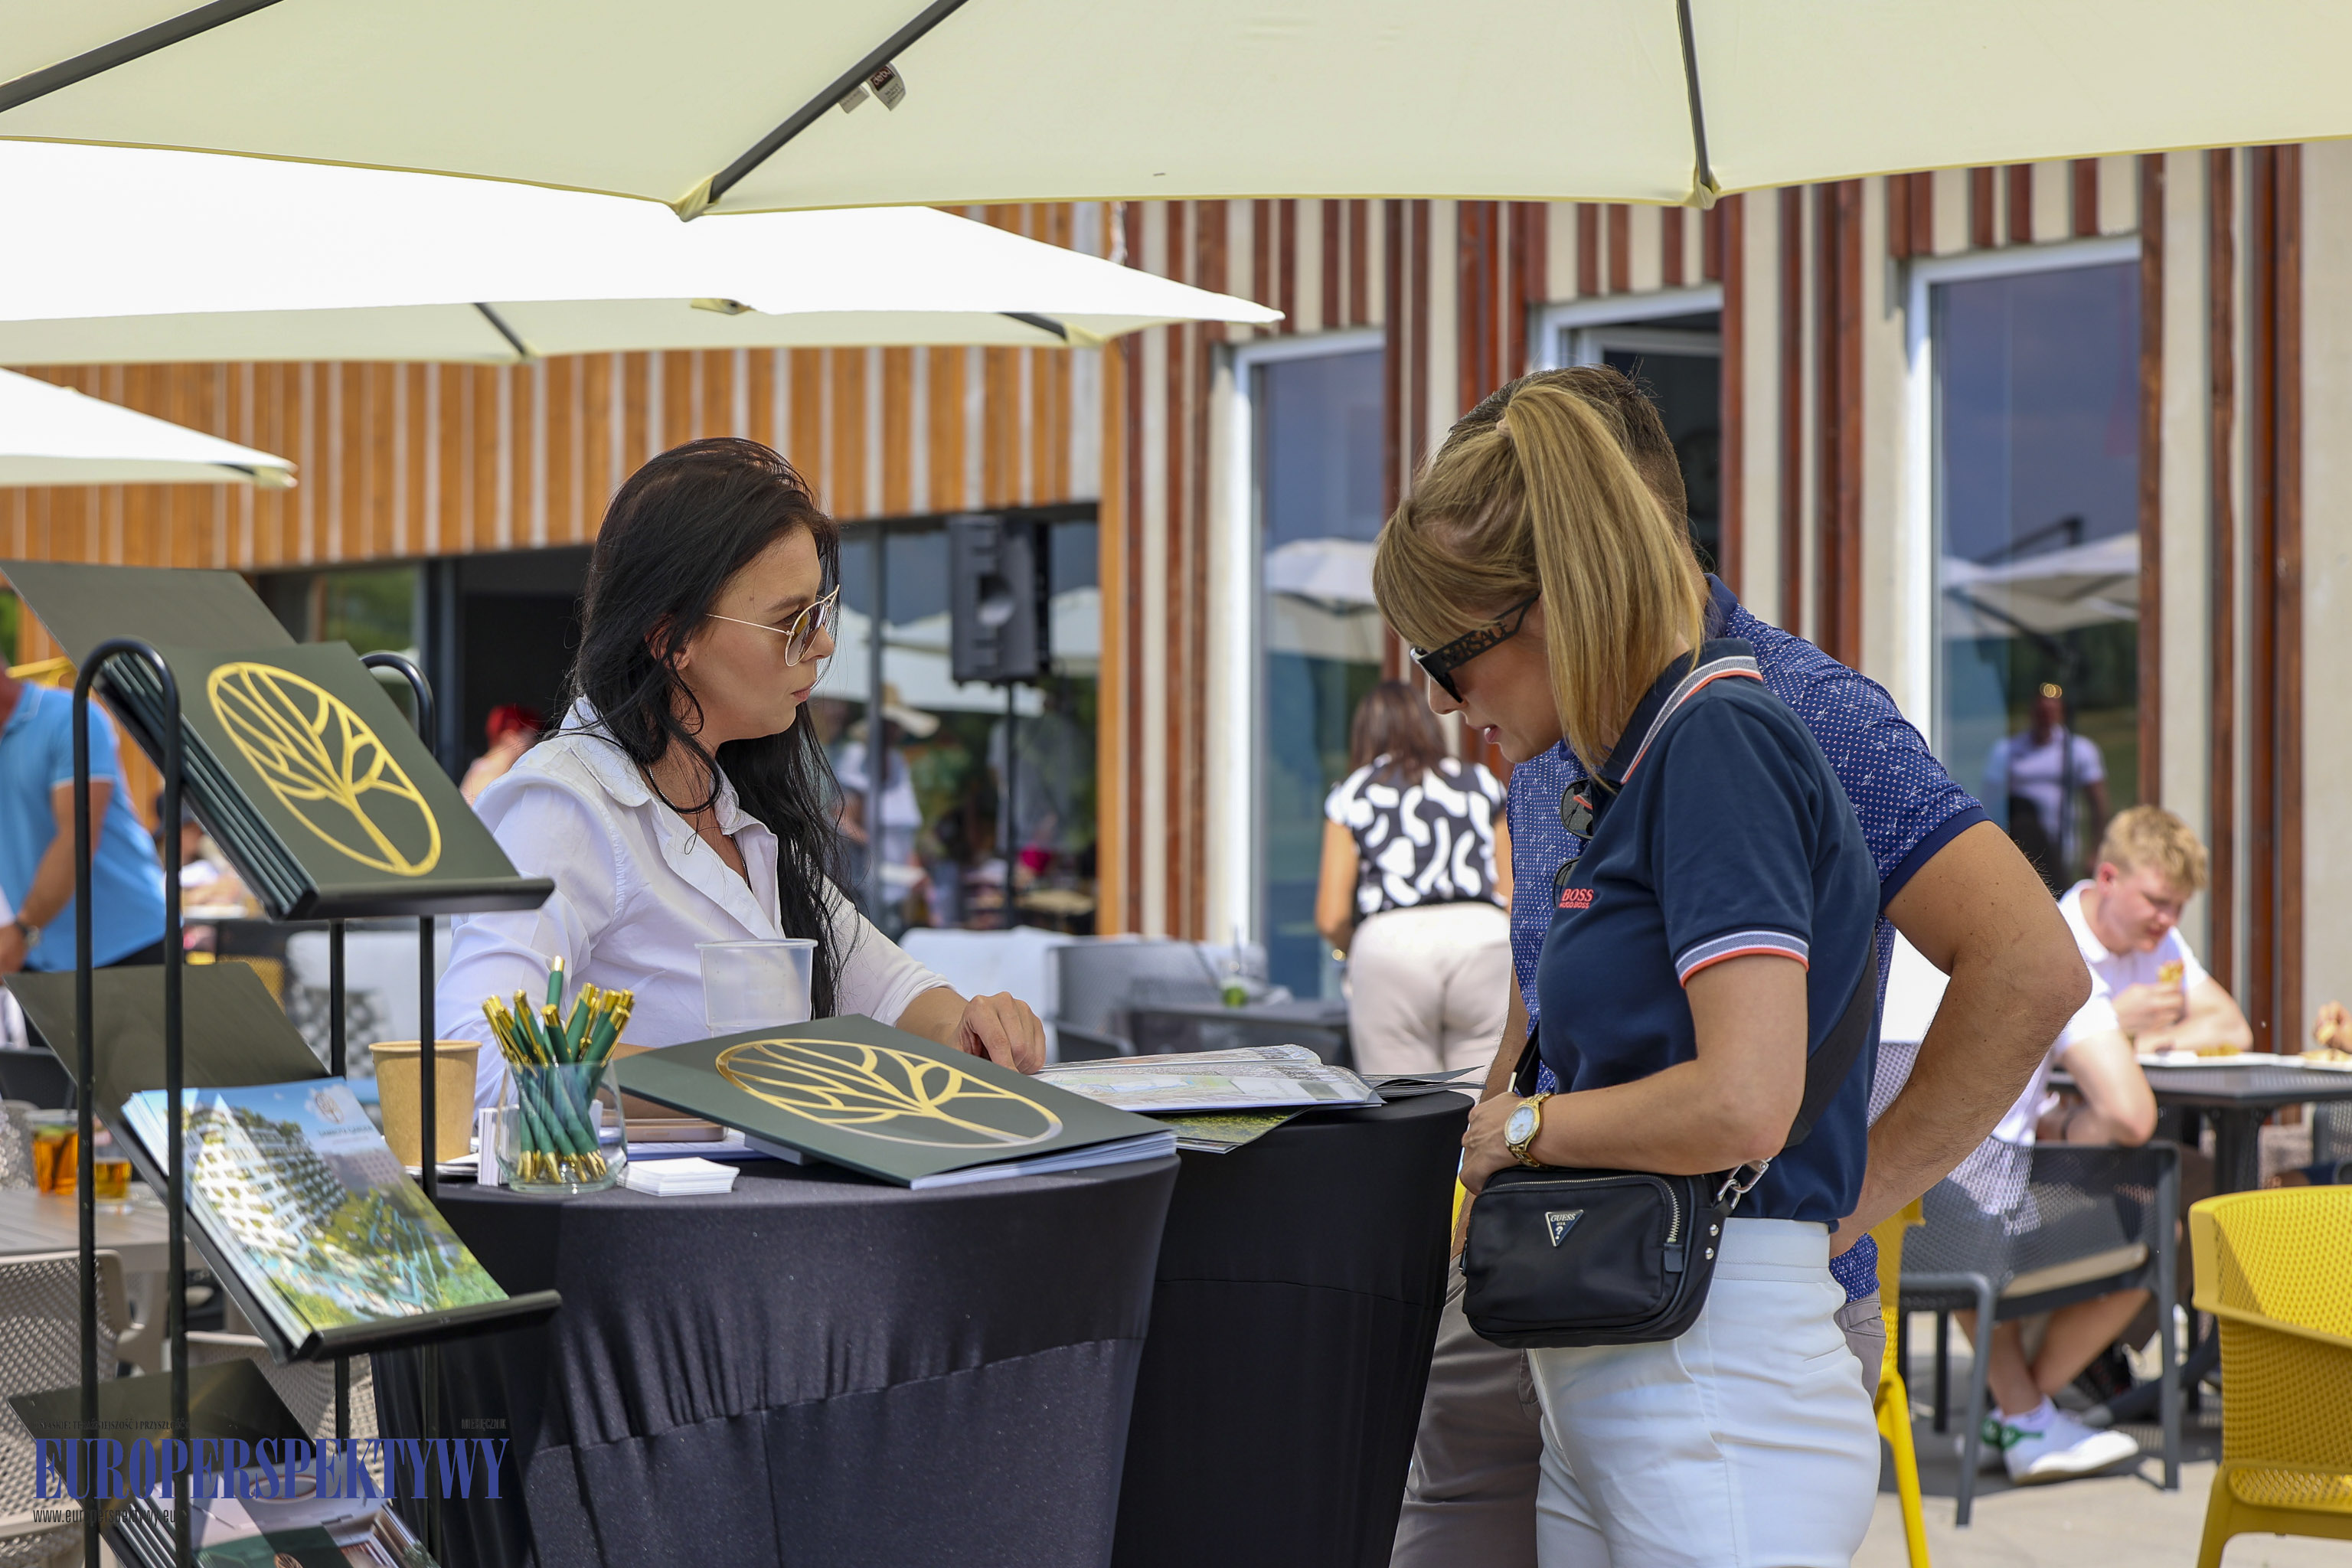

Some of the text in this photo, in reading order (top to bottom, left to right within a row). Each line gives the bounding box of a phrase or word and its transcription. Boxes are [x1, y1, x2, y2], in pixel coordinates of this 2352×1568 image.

[1561, 888, 1594, 902] BOSS
[1573, 901, 1591, 910] BOSS
[1550, 1214, 1576, 1222] GUESS
